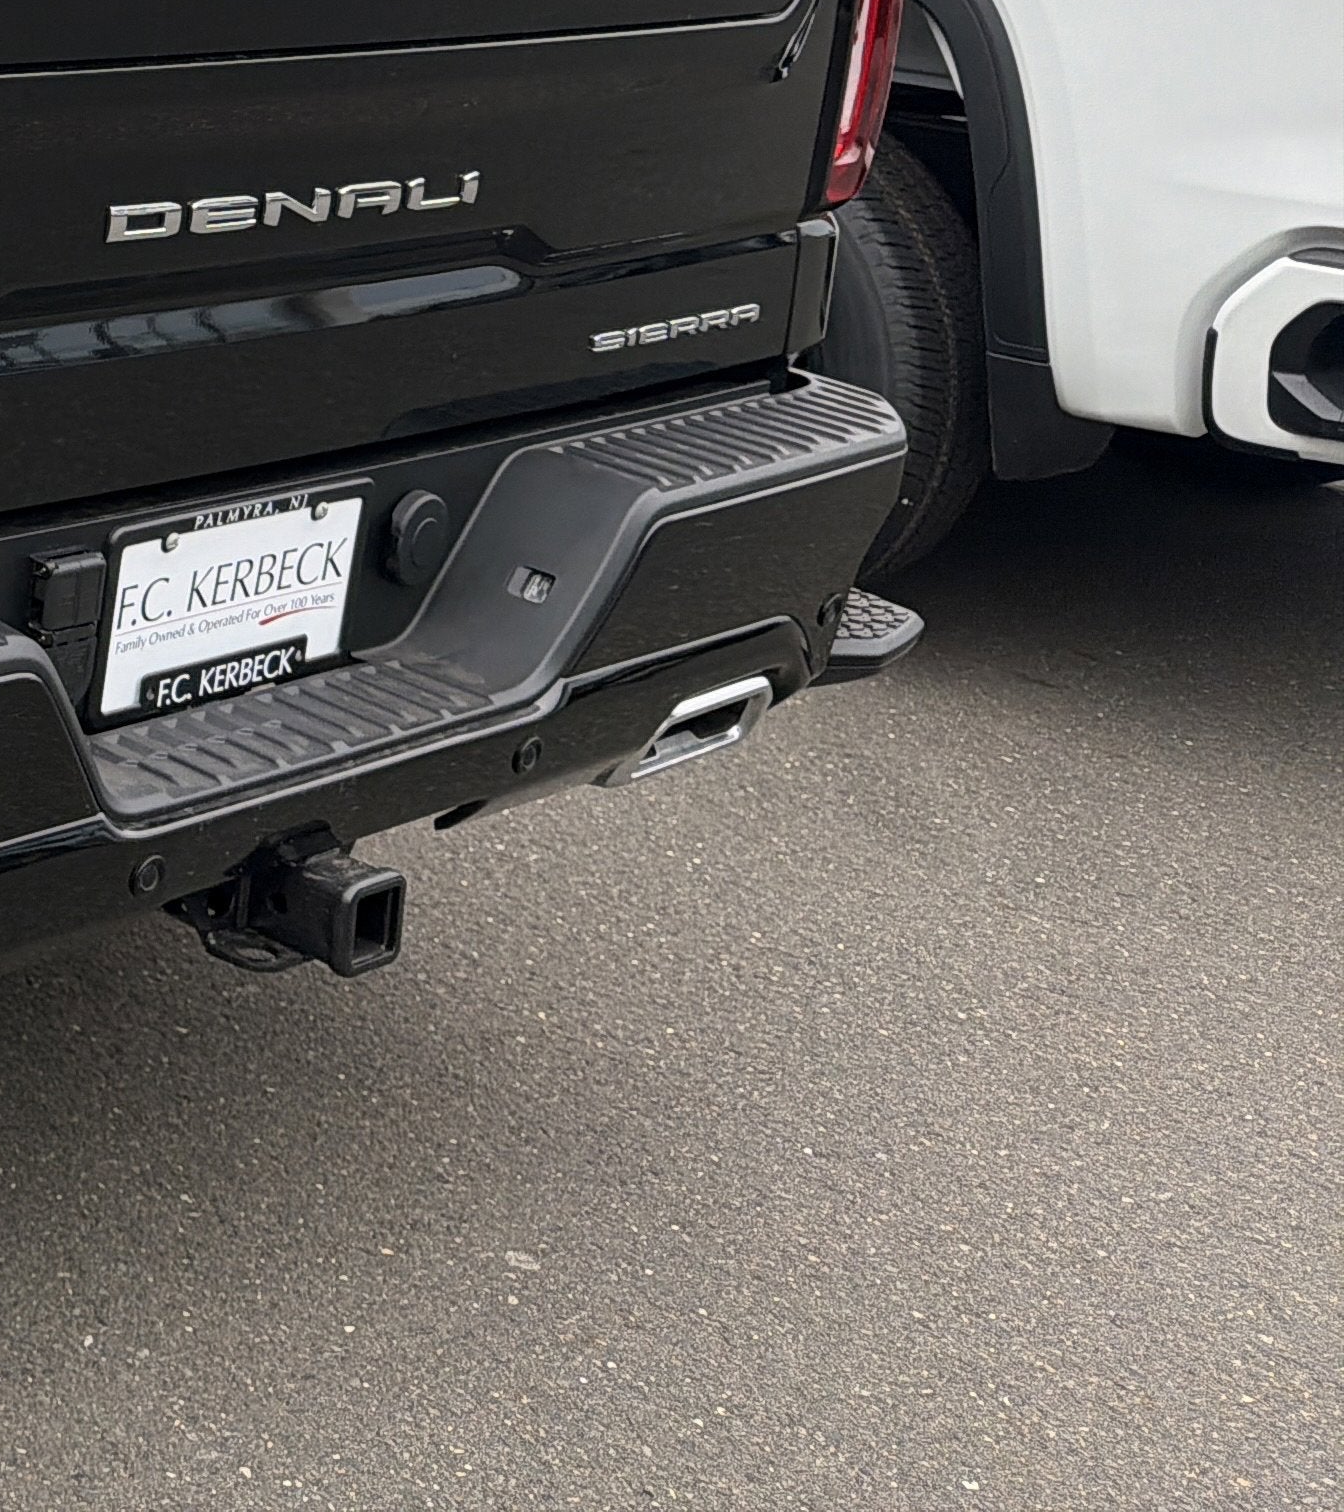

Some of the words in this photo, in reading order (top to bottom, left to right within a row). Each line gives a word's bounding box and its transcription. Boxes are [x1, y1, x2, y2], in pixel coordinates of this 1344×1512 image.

[105, 170, 480, 243] DENALI
[588, 303, 761, 353] SIERRA
[194, 500, 280, 530] PALMYRA,
[116, 578, 172, 630] F.C.
[186, 537, 348, 612] KERBECK
[114, 635, 148, 655] Family
[148, 628, 186, 646] Owned
[187, 622, 195, 636] &
[198, 610, 244, 635] Operated
[245, 606, 262, 621] For
[263, 601, 288, 616] Over
[289, 596, 308, 610] 100
[310, 591, 336, 606] Years
[156, 673, 193, 708] F.C.
[198, 646, 296, 697] KERBECK
